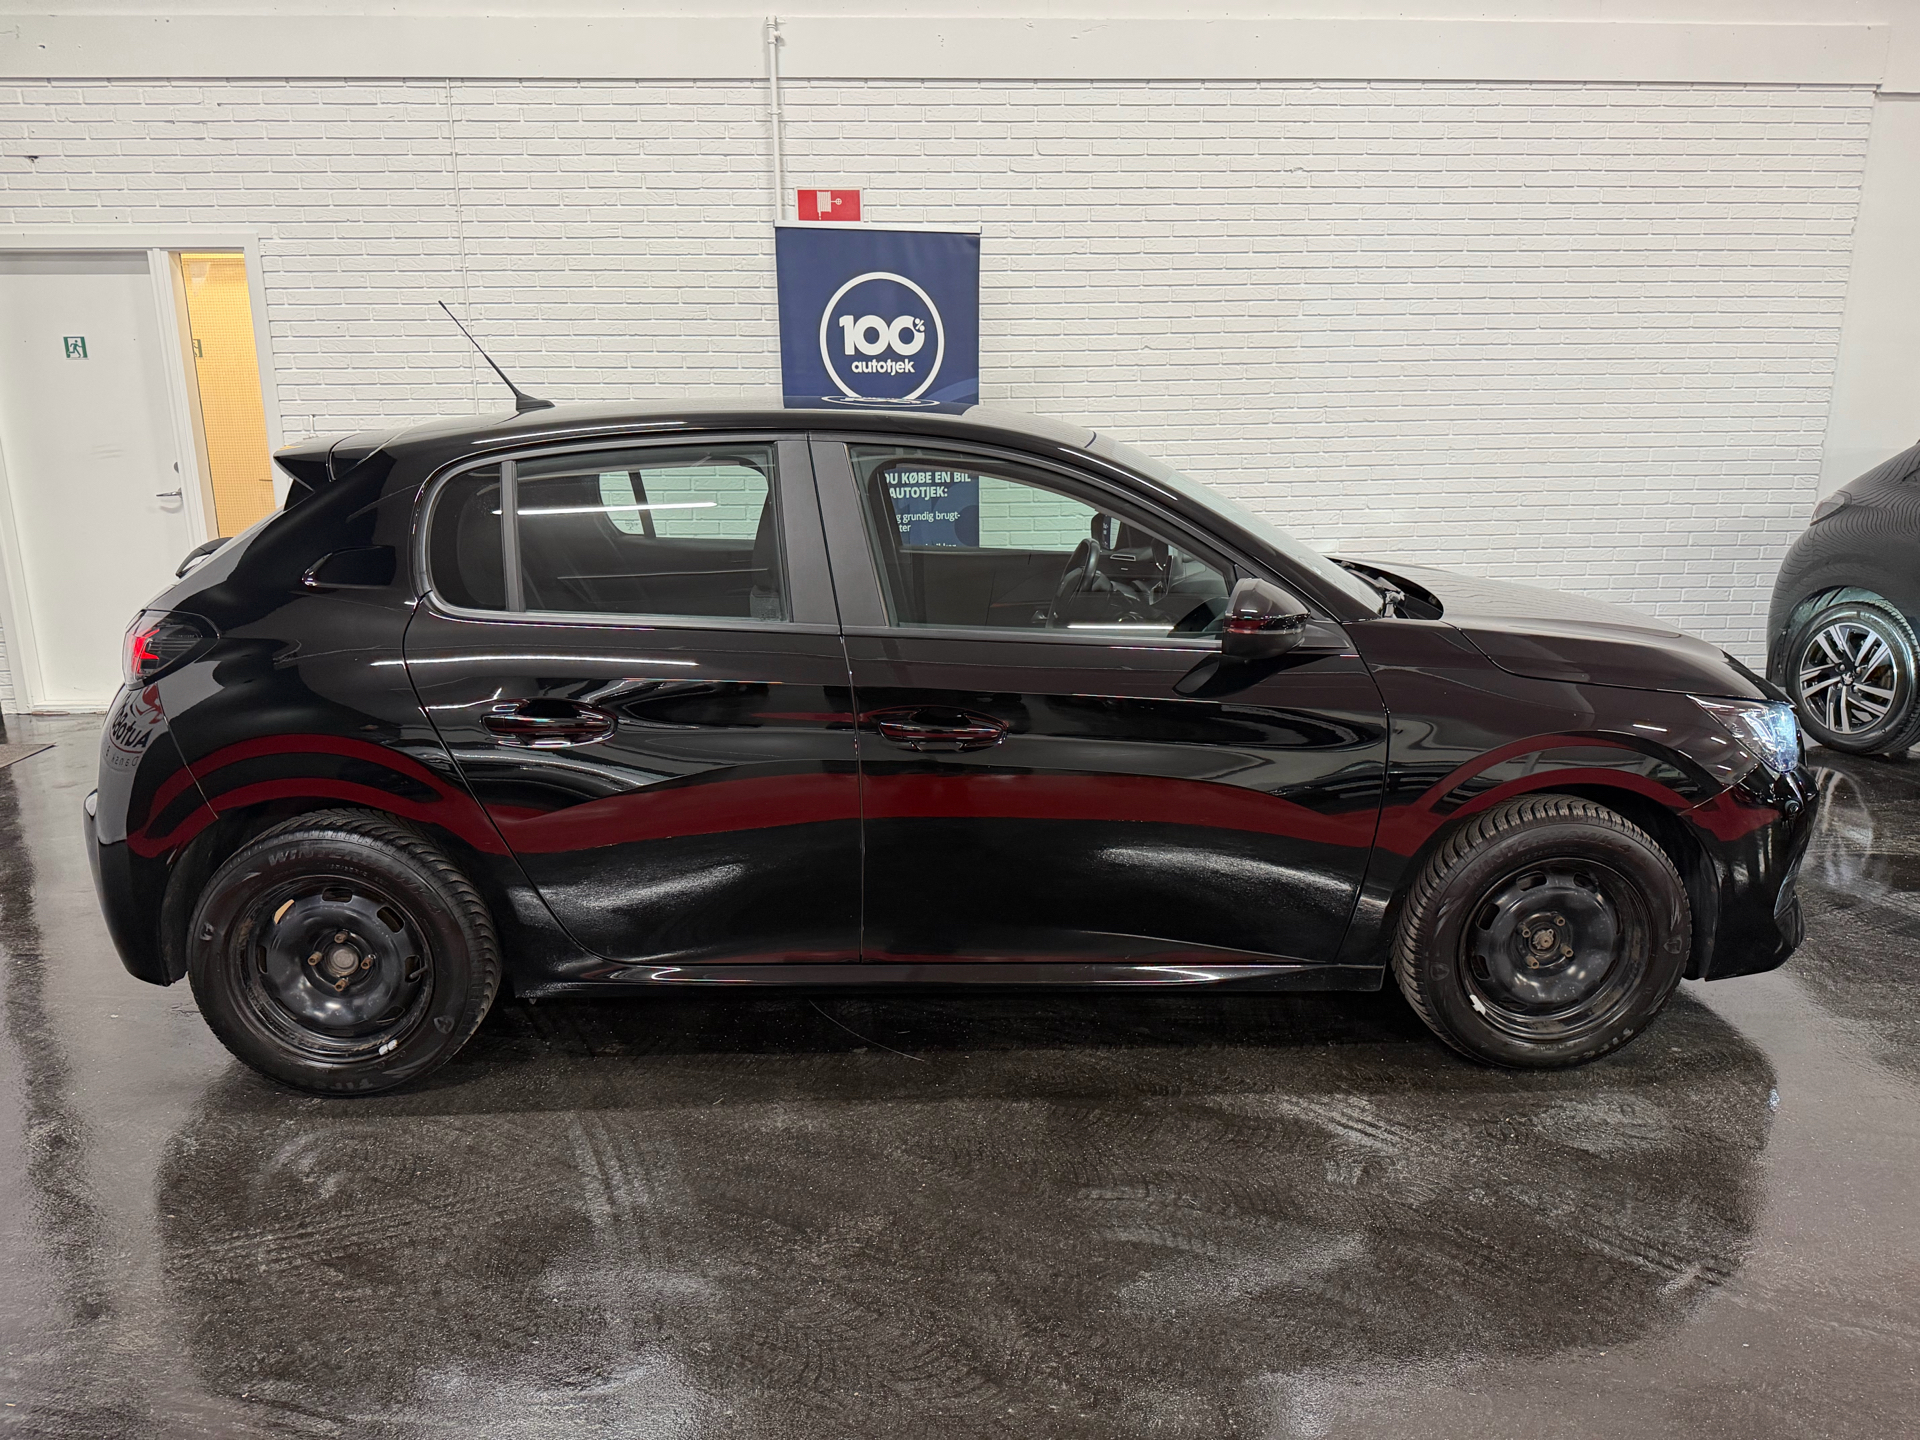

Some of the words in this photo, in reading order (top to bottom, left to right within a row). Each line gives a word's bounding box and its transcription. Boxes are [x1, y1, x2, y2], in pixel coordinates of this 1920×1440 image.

[839, 314, 925, 356] 100%
[851, 358, 916, 376] autotjek
[901, 472, 932, 485] KØBE
[935, 471, 951, 484] EN
[953, 472, 971, 483] BIL
[889, 486, 948, 501] AUTOTJEK:
[902, 511, 934, 523] grundig
[935, 511, 961, 522] brugt-
